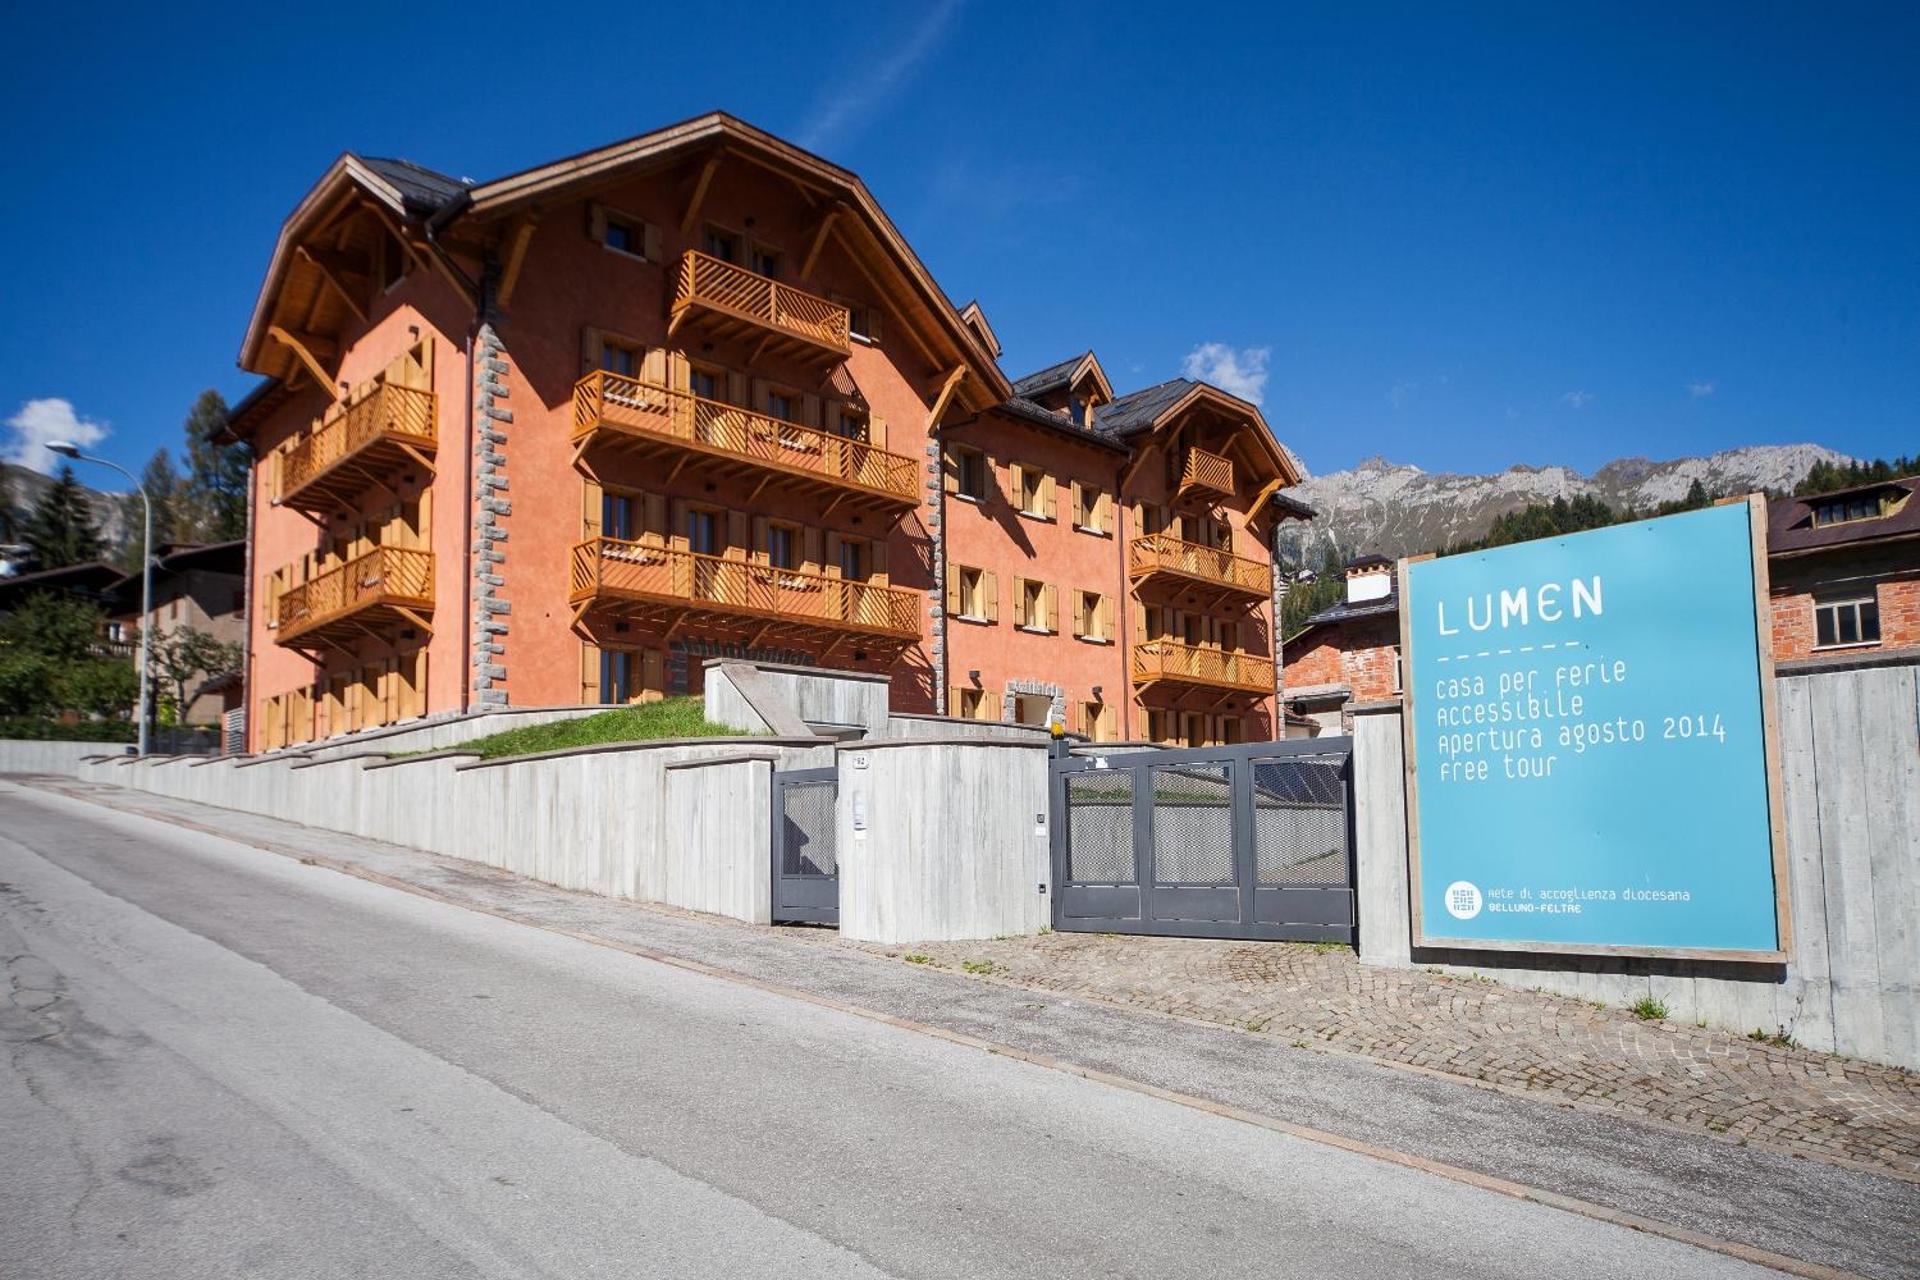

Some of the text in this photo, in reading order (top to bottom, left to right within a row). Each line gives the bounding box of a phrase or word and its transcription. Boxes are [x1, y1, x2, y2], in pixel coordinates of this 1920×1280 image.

[1438, 575, 1603, 635] LUMEN
[1436, 676, 1485, 700] casa
[1499, 670, 1538, 700] per
[1558, 716, 1646, 753] agosto
[1663, 713, 1727, 744] 2014
[1503, 754, 1558, 779] tour
[1488, 903, 1583, 914] BELLUNO-FELTRE
[1520, 887, 1533, 900] di
[1540, 886, 1616, 904] accoglienza
[1623, 887, 1691, 901] diocesana
